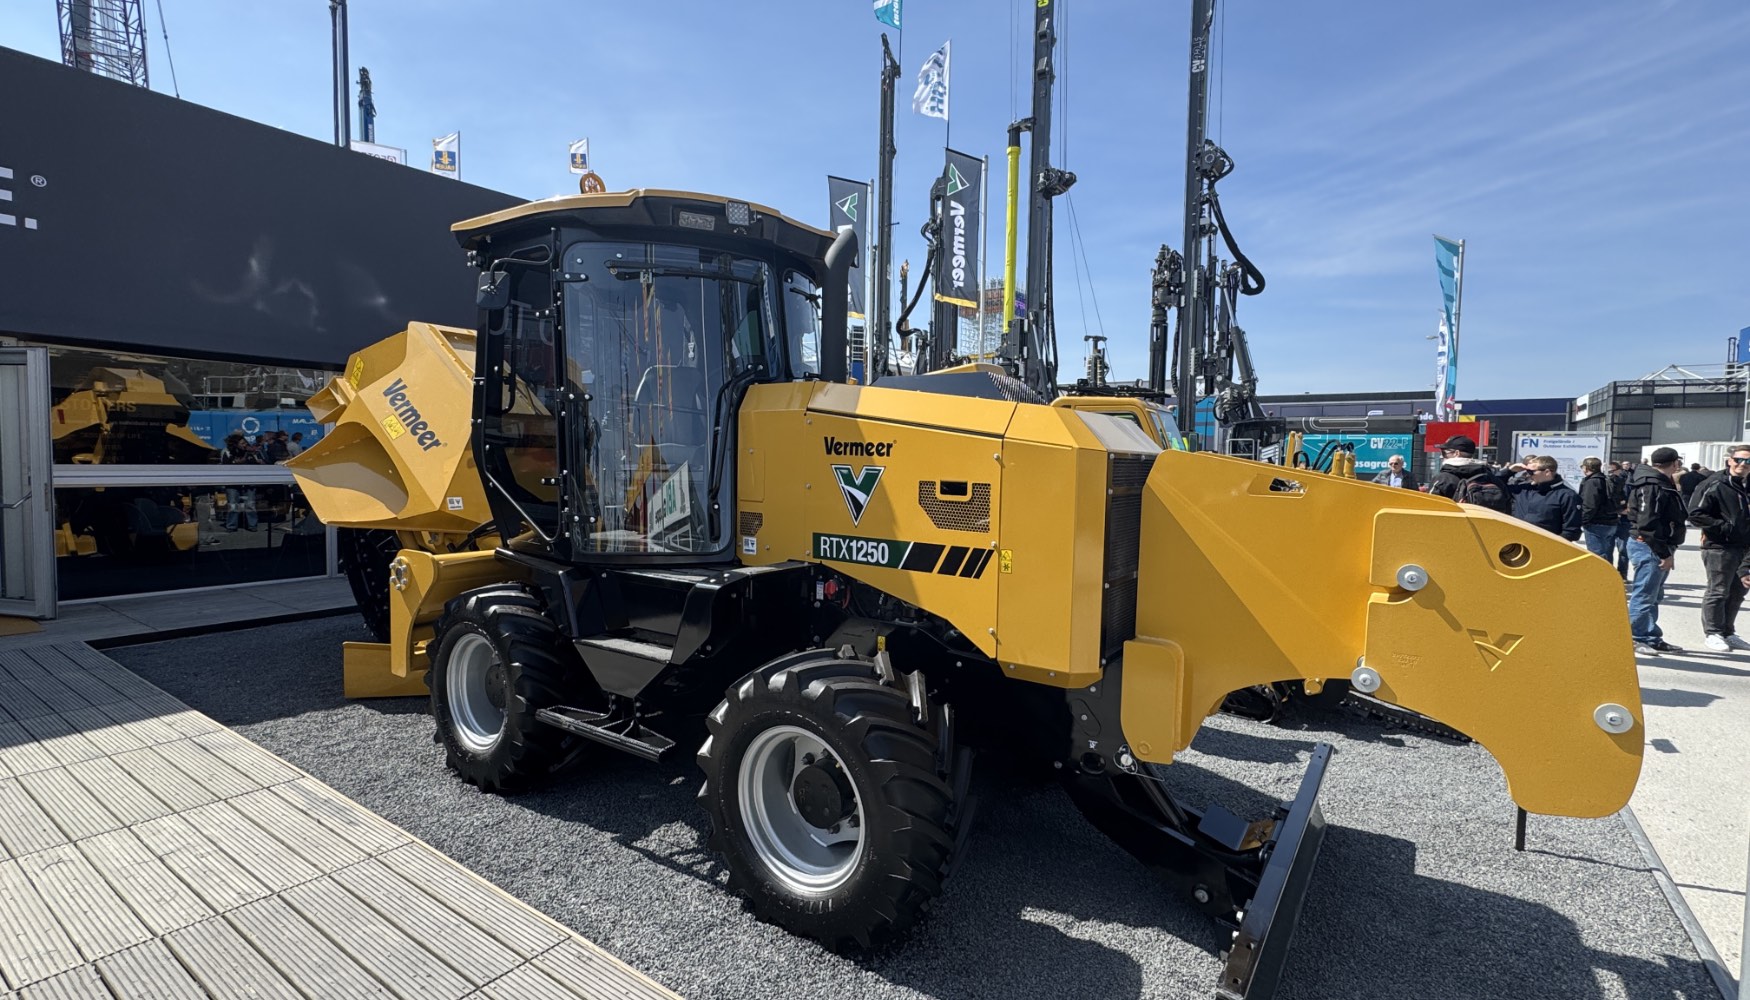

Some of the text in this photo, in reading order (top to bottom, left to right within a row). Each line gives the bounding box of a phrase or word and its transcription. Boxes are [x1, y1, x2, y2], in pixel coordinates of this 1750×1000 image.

[383, 377, 442, 452] Vermeer
[824, 436, 893, 457] Vermeer
[1521, 438, 1539, 448] FN
[820, 536, 889, 564] RTX1250
